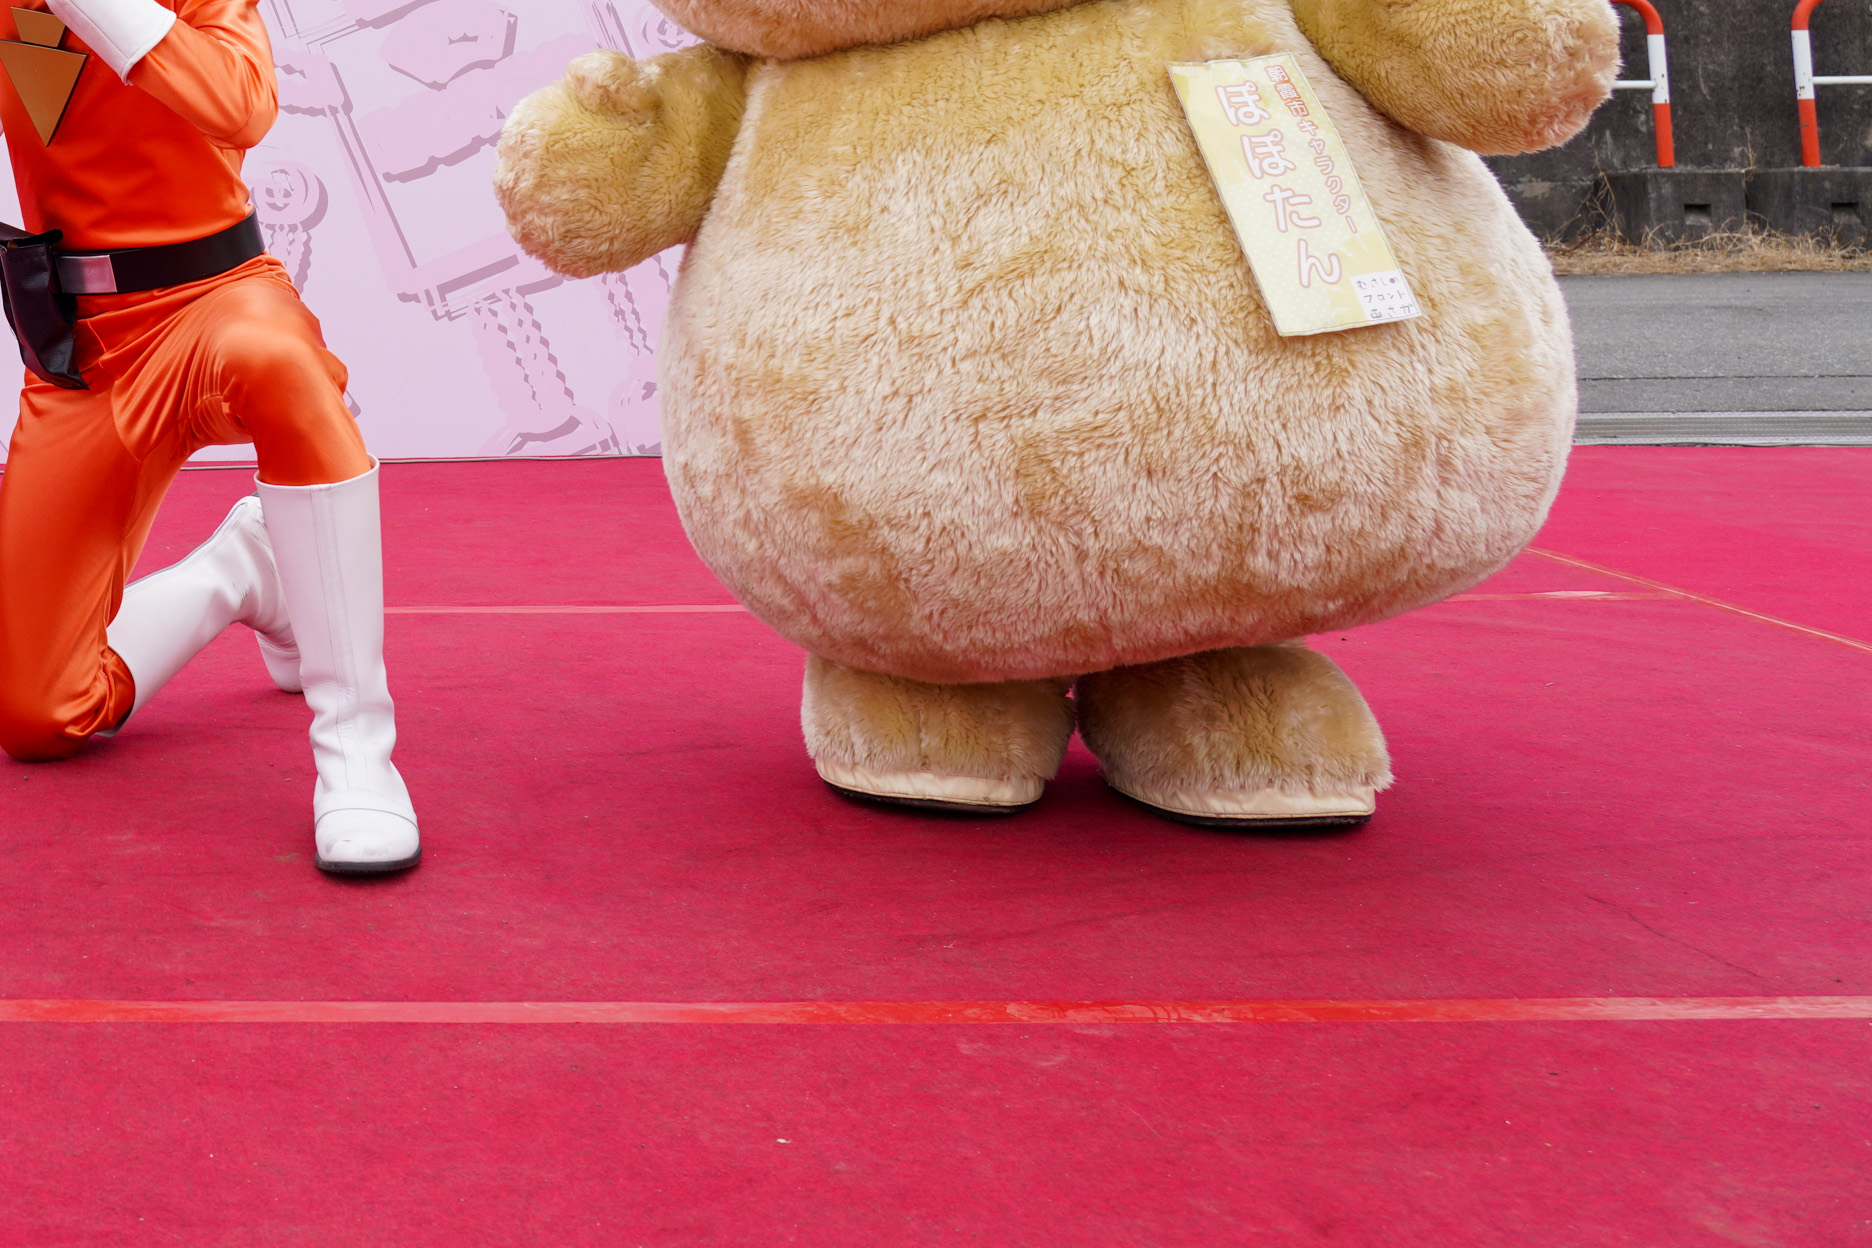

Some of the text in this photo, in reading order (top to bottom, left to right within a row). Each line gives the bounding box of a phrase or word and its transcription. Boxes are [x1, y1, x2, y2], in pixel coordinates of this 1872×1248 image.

[1214, 80, 1343, 289] ぽぽたん
[1263, 64, 1357, 234] 朝霞市キャラクター
